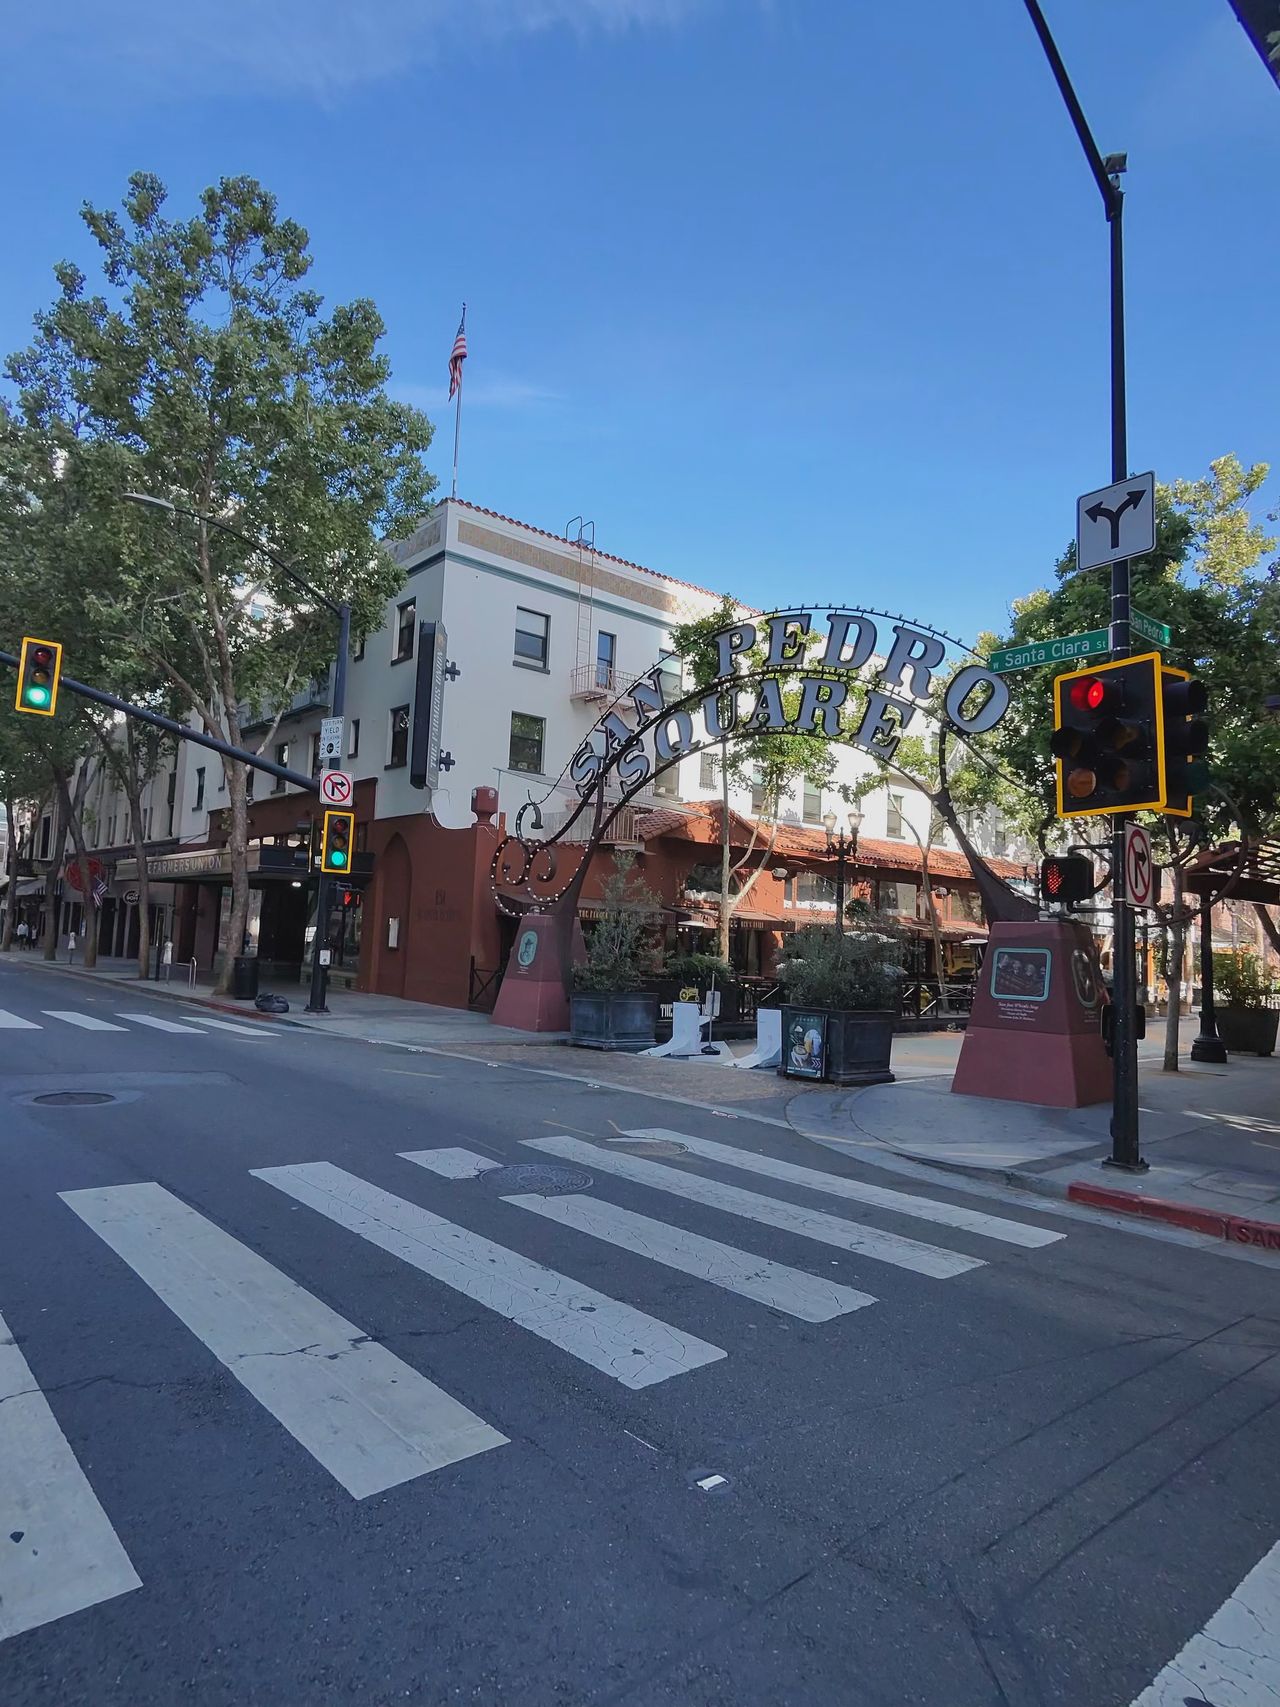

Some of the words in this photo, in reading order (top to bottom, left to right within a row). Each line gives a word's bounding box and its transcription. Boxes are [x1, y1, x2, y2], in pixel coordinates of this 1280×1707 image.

[1130, 611, 1143, 628] San
[1143, 619, 1164, 641] Pedro
[1005, 650, 1045, 667] Santa
[1051, 640, 1090, 658] Clara
[1096, 640, 1106, 649] St
[435, 651, 444, 685] UNION
[431, 686, 442, 742] FARMERS
[570, 668, 669, 797] SAN
[713, 612, 1011, 735] PEDRO
[325, 726, 340, 734] YIELD
[616, 676, 916, 796] SQUARE
[430, 743, 438, 768] THE
[153, 860, 190, 874] FARMERS
[191, 855, 221, 872] UNION
[660, 1003, 673, 1018] THE
